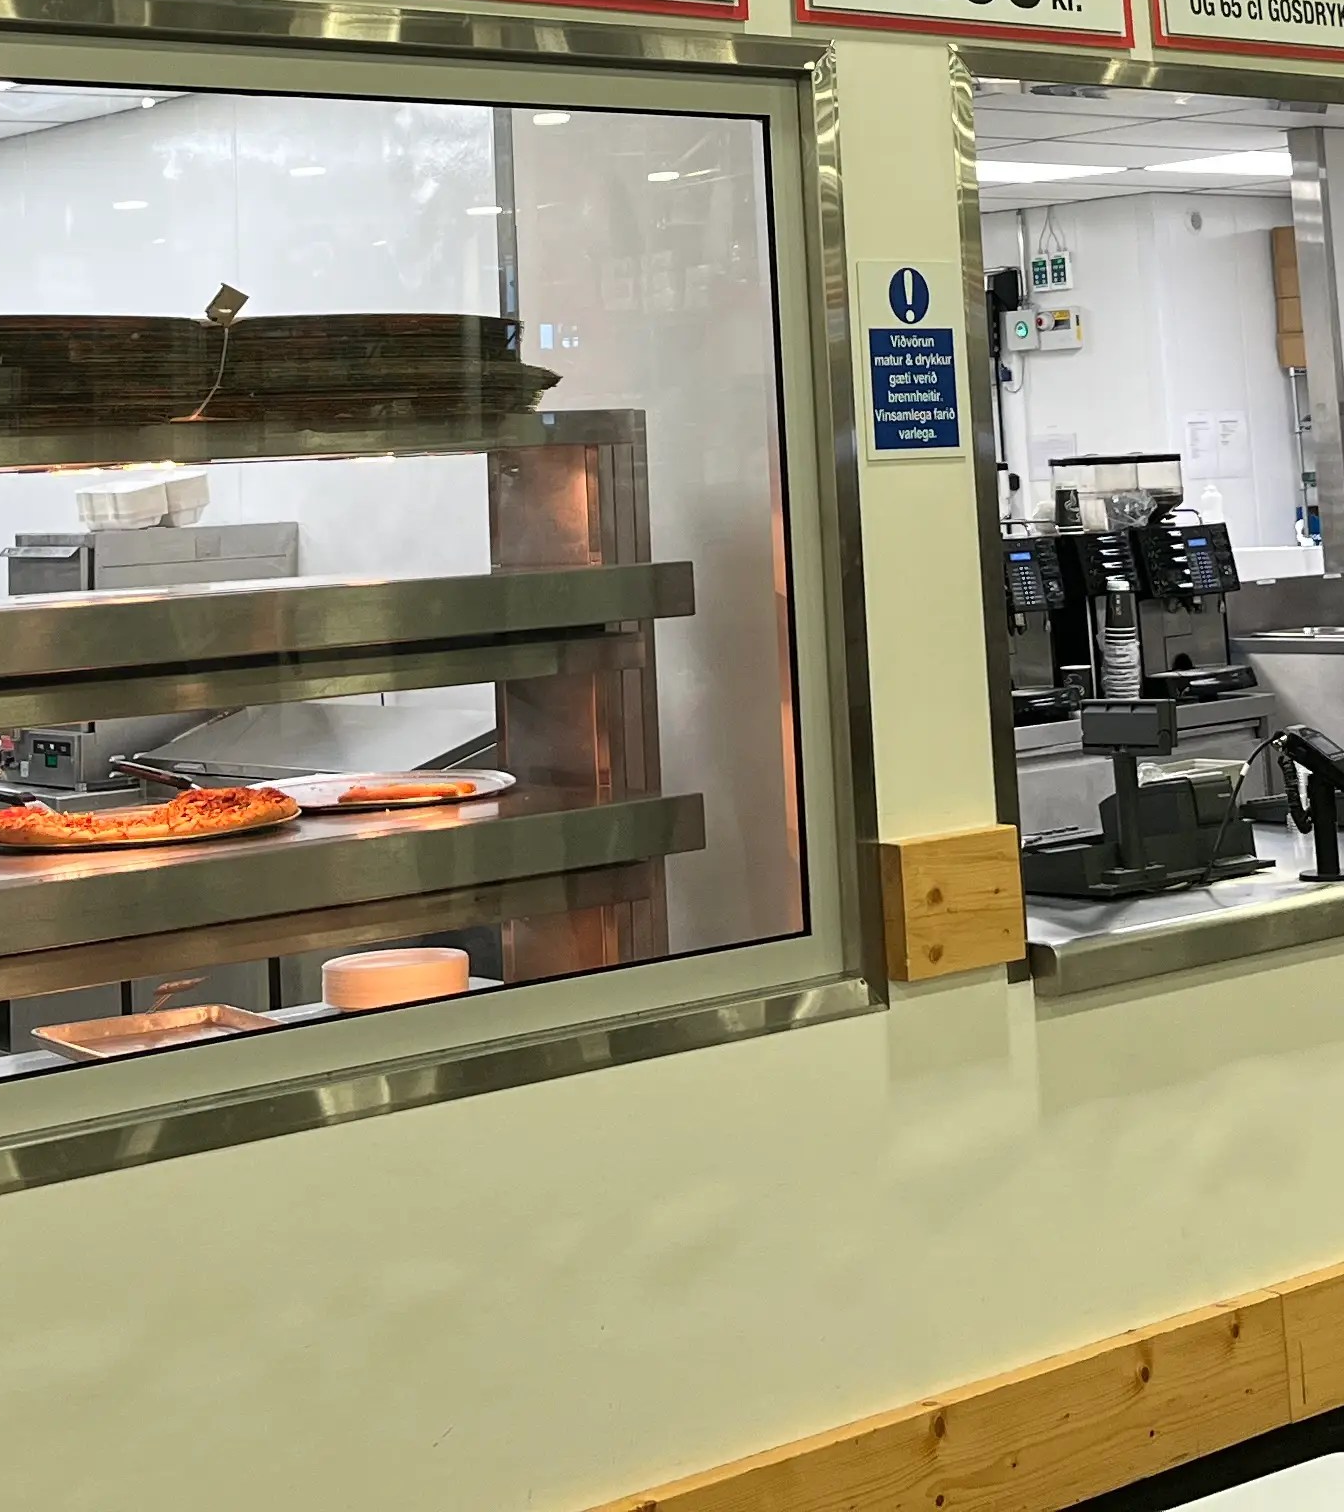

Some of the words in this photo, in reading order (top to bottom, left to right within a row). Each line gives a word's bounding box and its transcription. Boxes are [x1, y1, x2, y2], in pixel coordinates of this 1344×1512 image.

[889, 335, 934, 349] Viðvörun
[874, 354, 903, 367] matur
[905, 354, 913, 366] &
[915, 353, 952, 369] drykkur
[889, 372, 911, 388] gæti
[913, 370, 938, 384] verið
[875, 408, 932, 423] Vinsamlega
[934, 407, 955, 420] farið
[898, 427, 937, 442] varlega.
